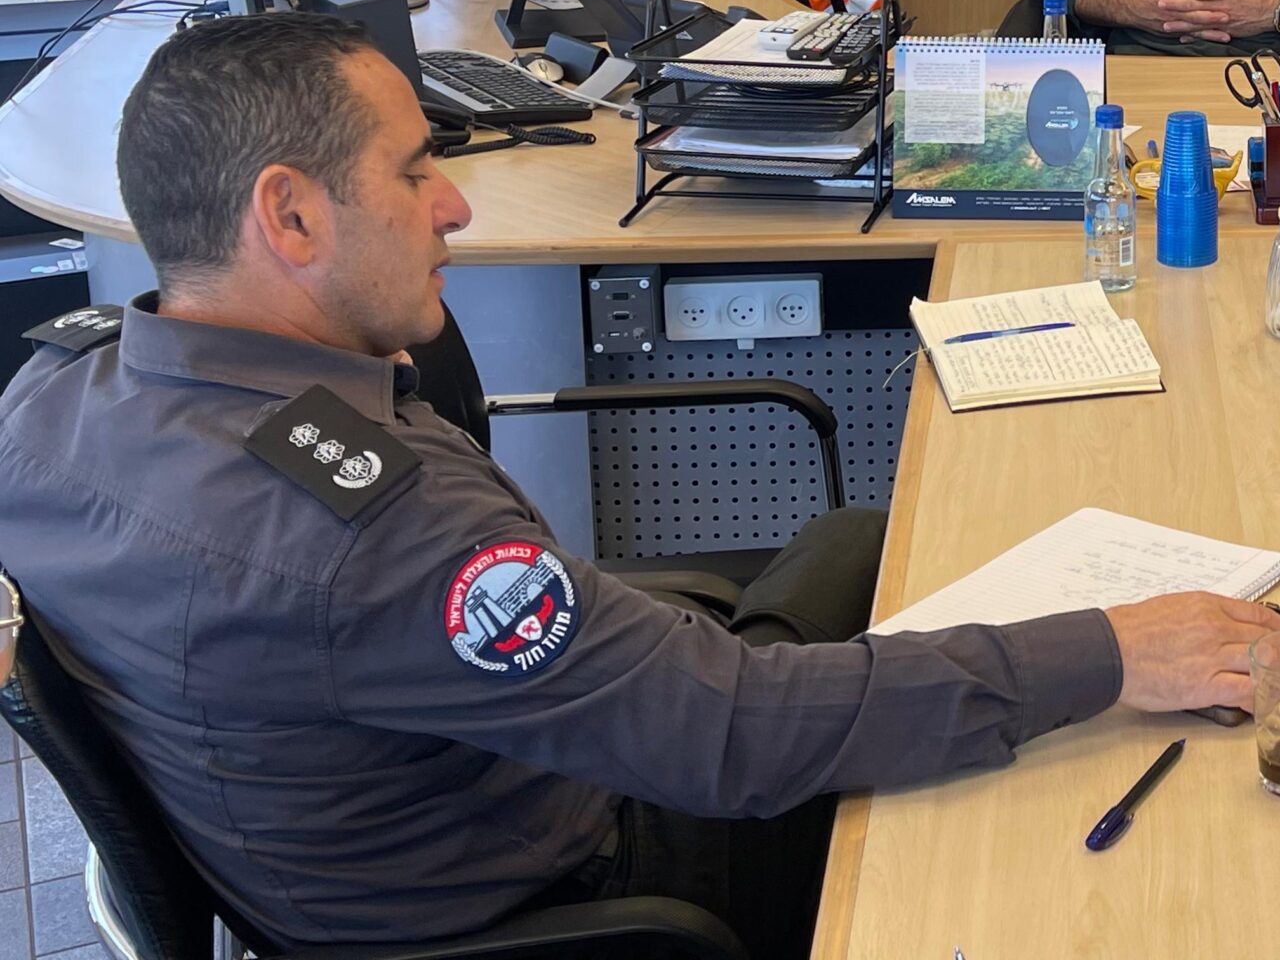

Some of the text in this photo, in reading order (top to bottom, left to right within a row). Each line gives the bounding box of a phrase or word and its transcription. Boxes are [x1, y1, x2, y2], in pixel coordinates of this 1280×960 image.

[449, 547, 531, 628] כבאות והצלה לישראל
[513, 611, 571, 671] מחוז חוף
